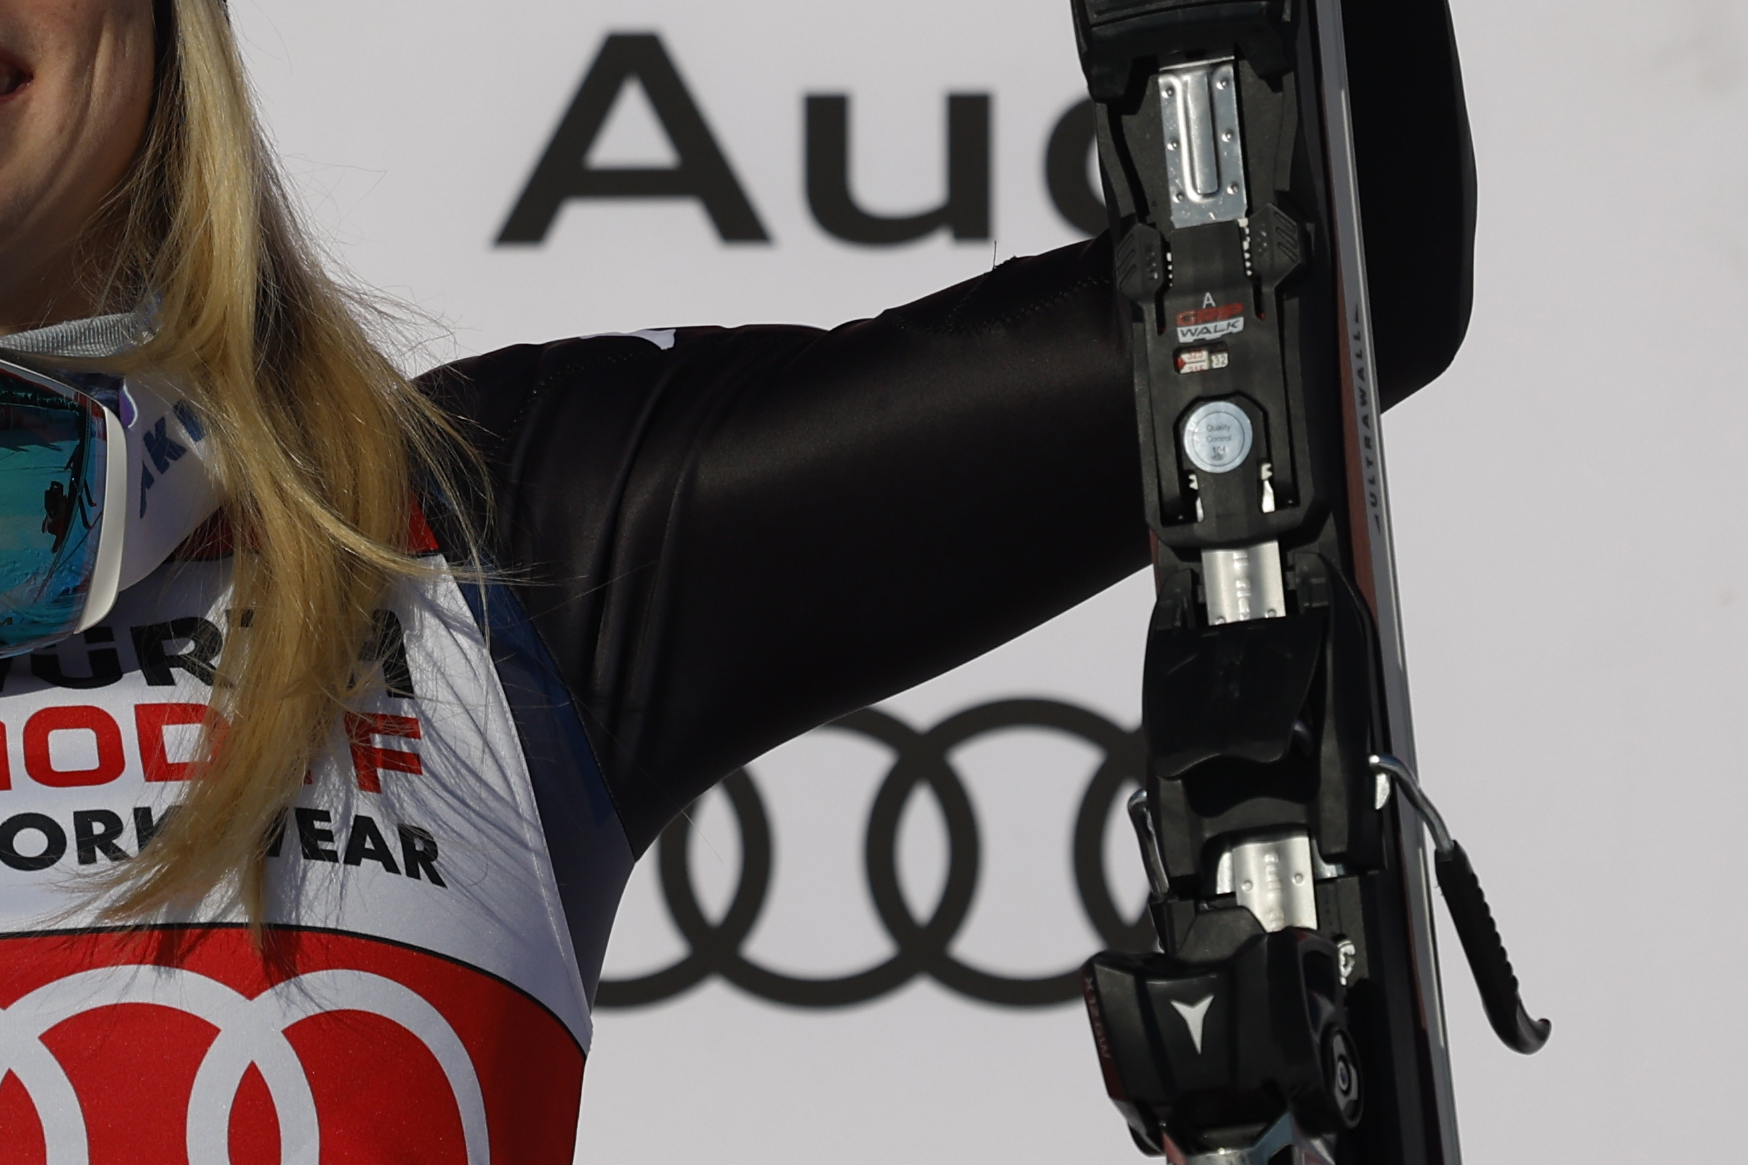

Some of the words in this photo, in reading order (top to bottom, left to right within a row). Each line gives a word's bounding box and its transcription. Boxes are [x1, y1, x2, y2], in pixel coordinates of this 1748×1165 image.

[1202, 291, 1216, 309] A
[1176, 303, 1245, 327] GRIP
[1180, 320, 1241, 338] WALK
[1354, 329, 1379, 509] ULTRAWALL
